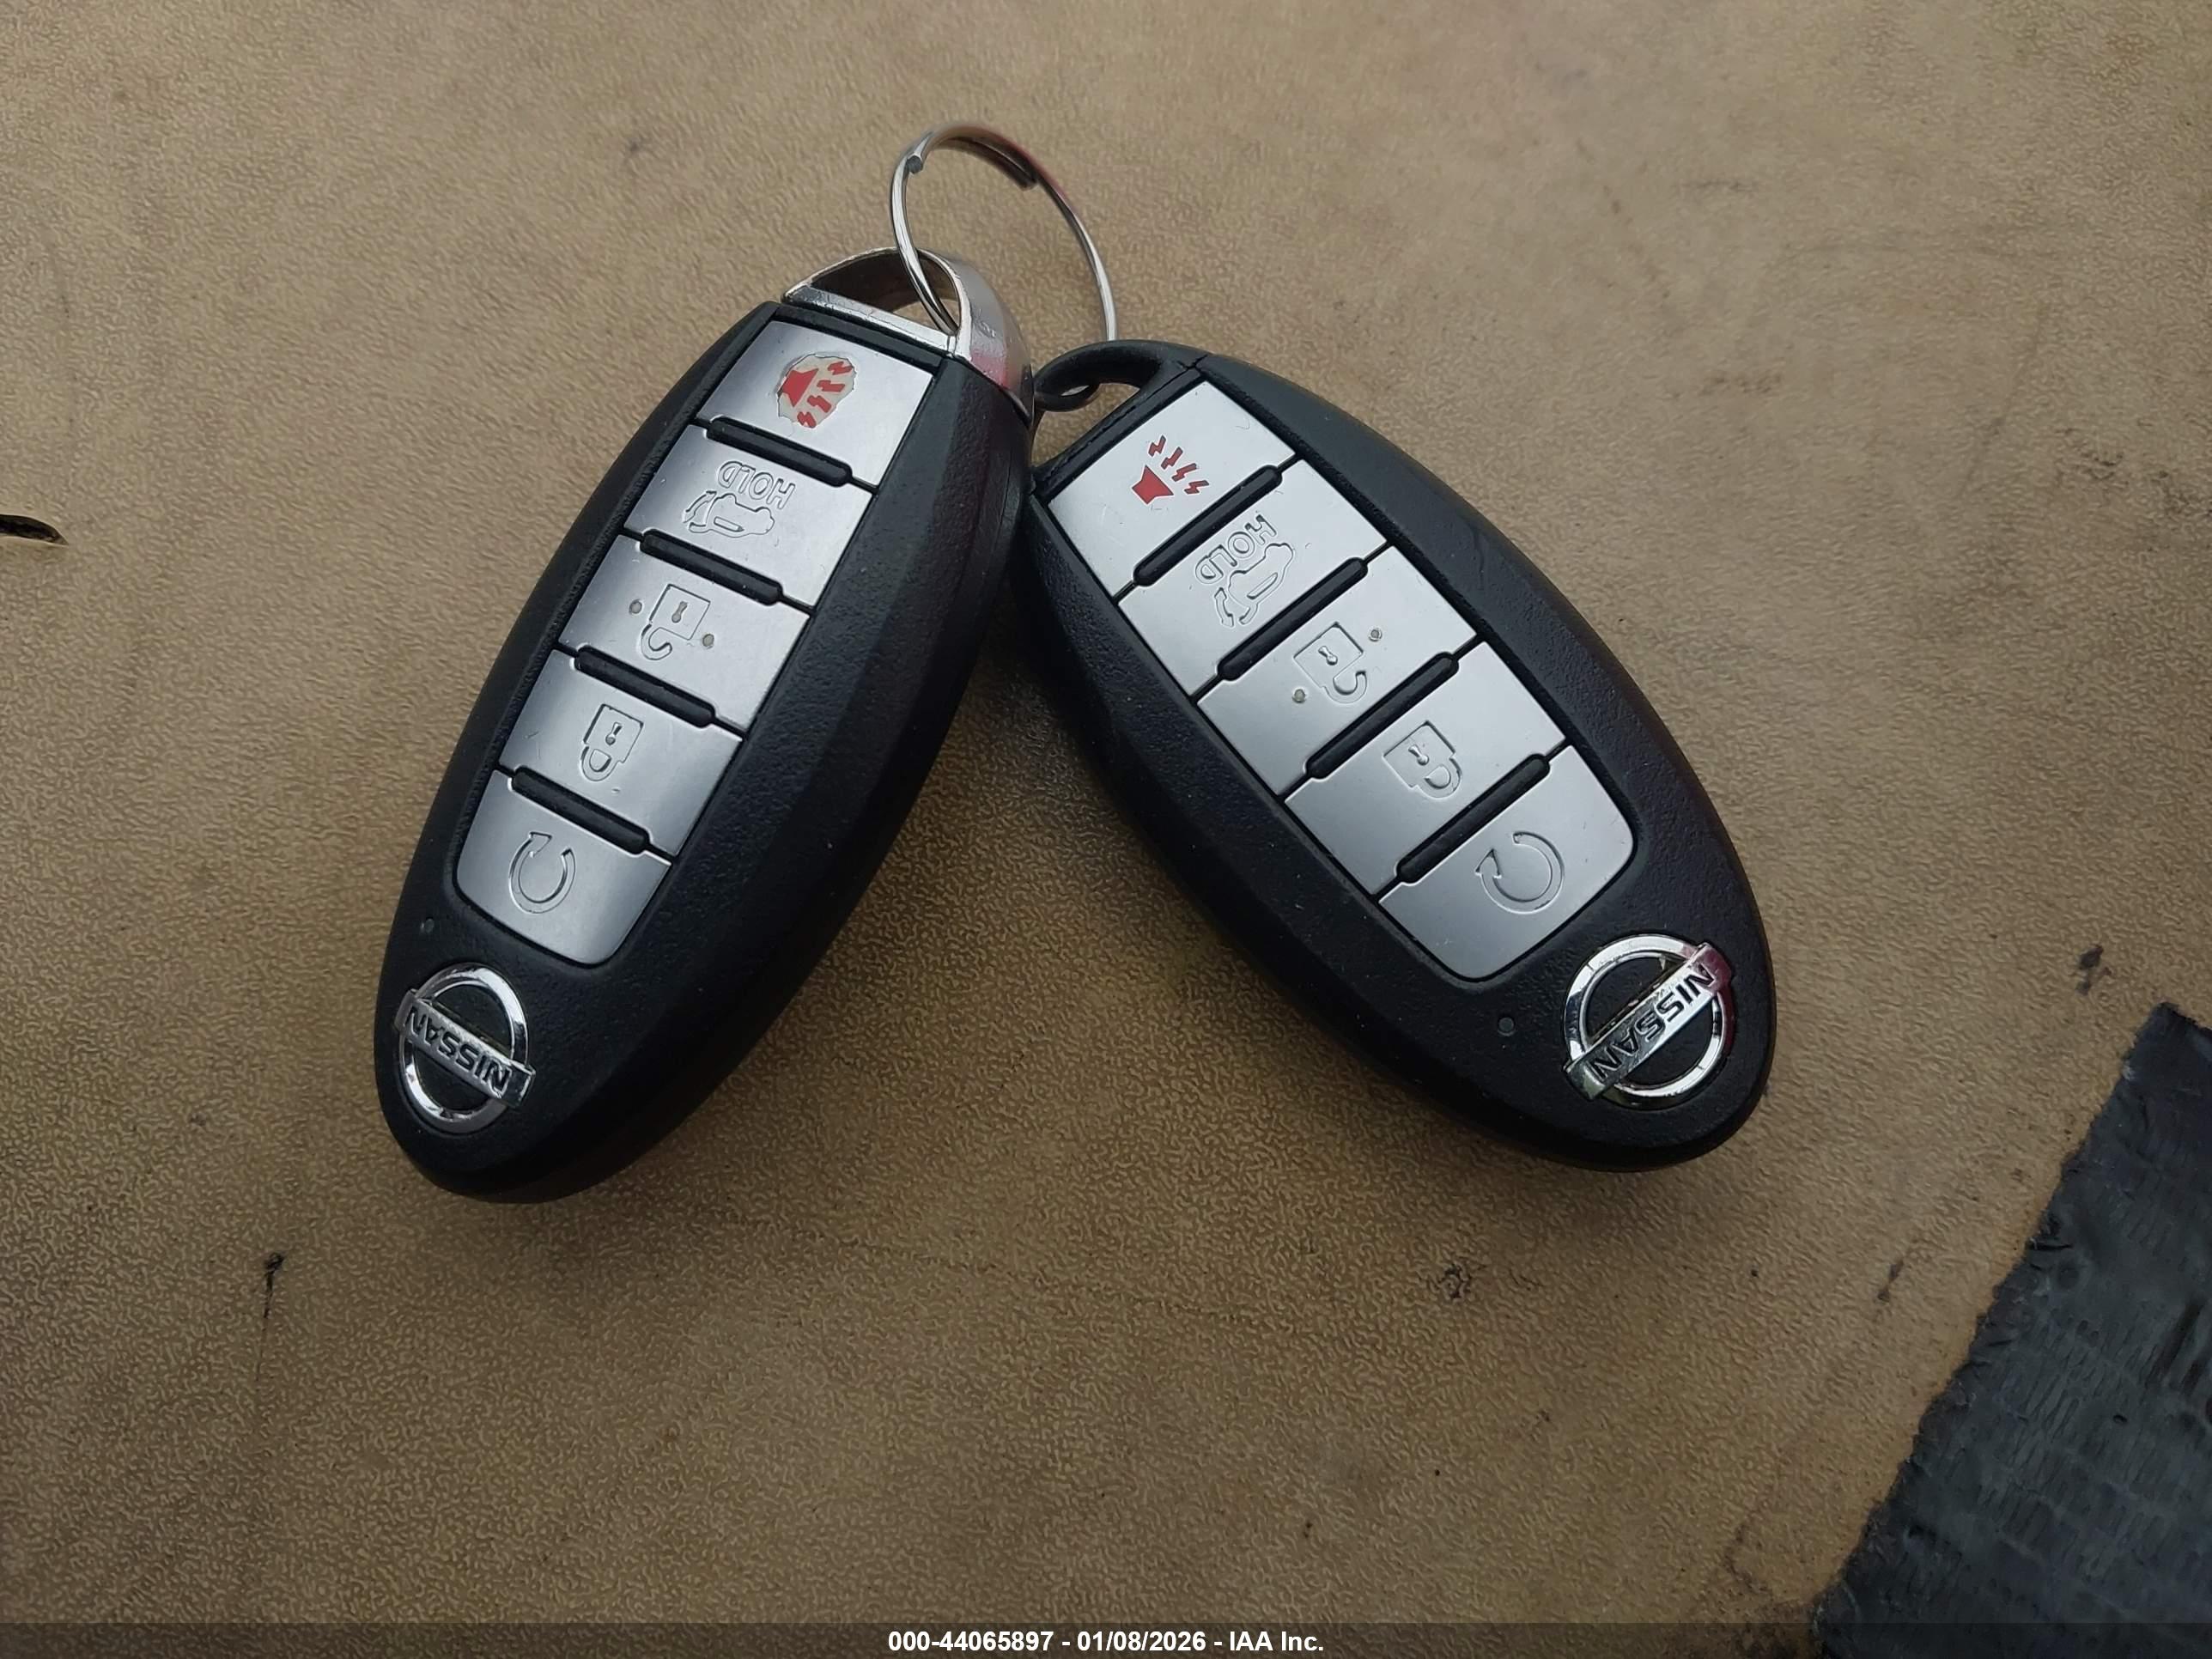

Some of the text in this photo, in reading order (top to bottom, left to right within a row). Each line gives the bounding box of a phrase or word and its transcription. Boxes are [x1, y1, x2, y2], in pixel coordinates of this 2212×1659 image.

[716, 460, 796, 510] HOLD
[1194, 514, 1278, 585] HOLD
[404, 1005, 514, 1095] NISSAN
[1589, 963, 1717, 1081] NISSAN
